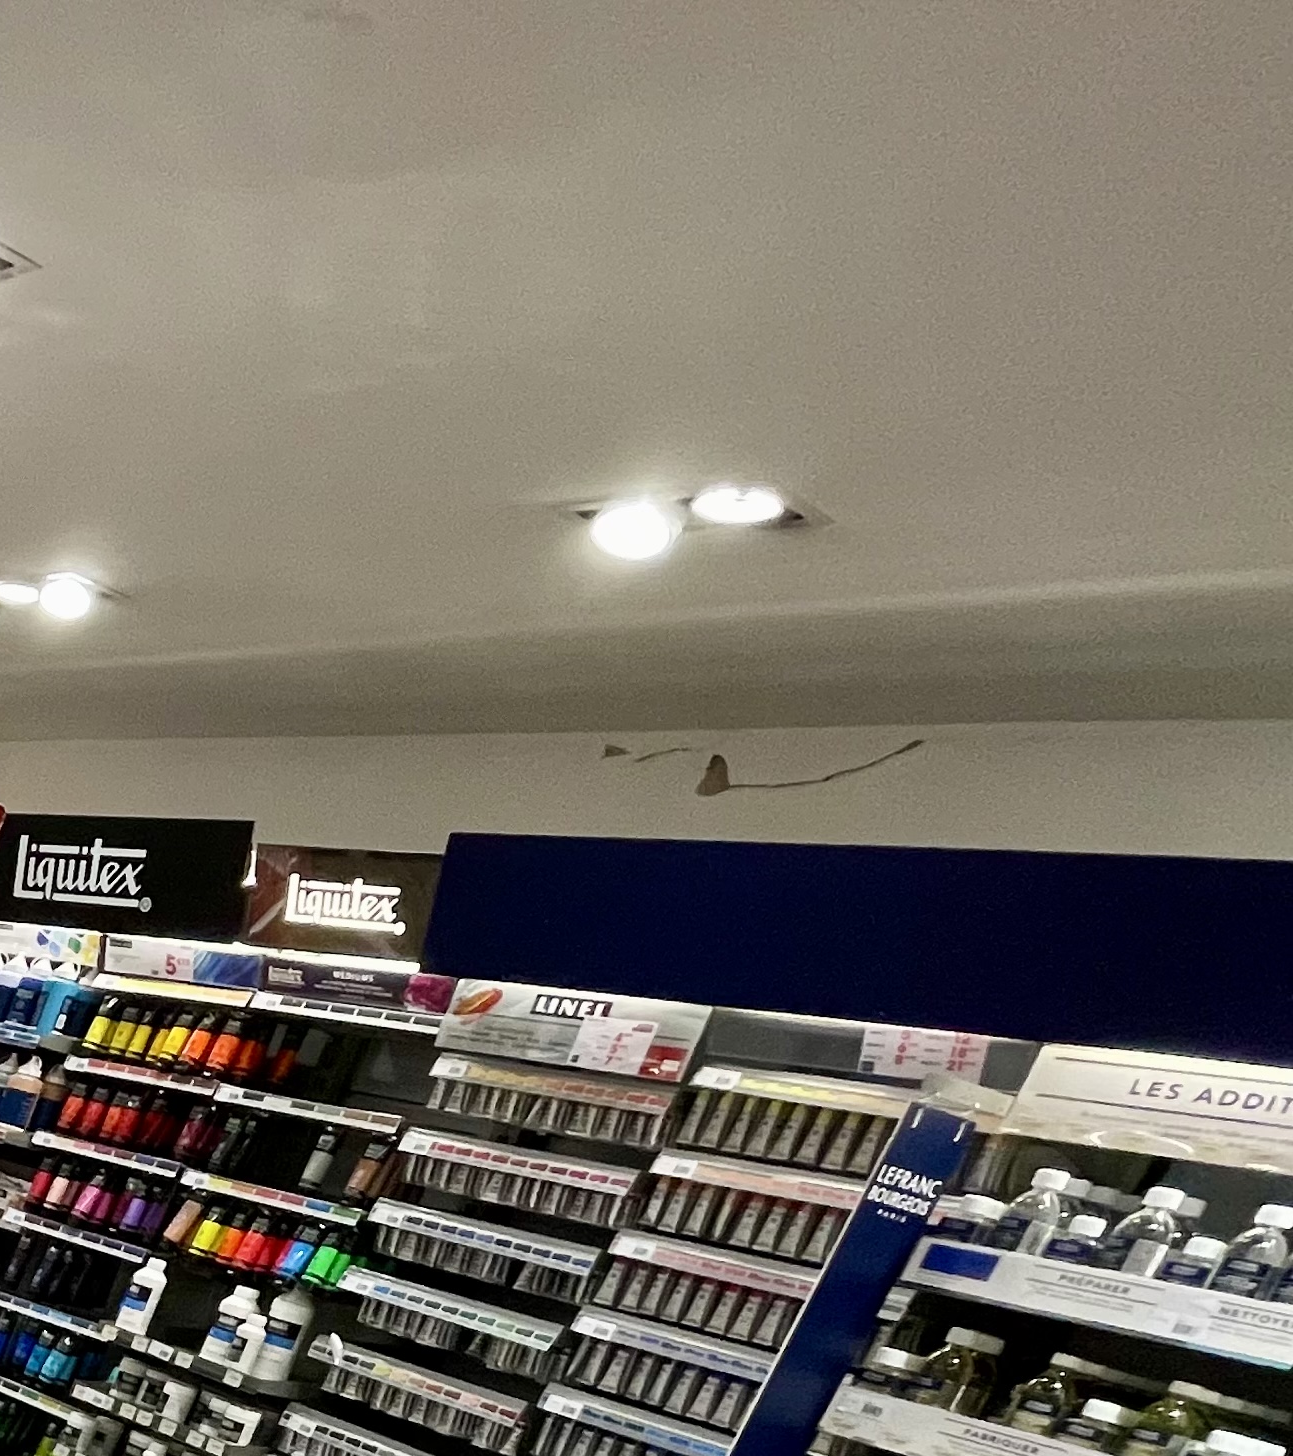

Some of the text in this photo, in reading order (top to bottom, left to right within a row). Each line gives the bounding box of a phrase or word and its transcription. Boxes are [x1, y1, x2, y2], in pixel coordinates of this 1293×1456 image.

[13, 835, 151, 911] Liquitex
[284, 873, 406, 936] Liquitex
[1129, 1078, 1293, 1115] LES ADDIT
[876, 1162, 943, 1200] LEFRANC
[866, 1184, 933, 1217] BOURGEOIS
[962, 1426, 1040, 1455] FABRIQUER
